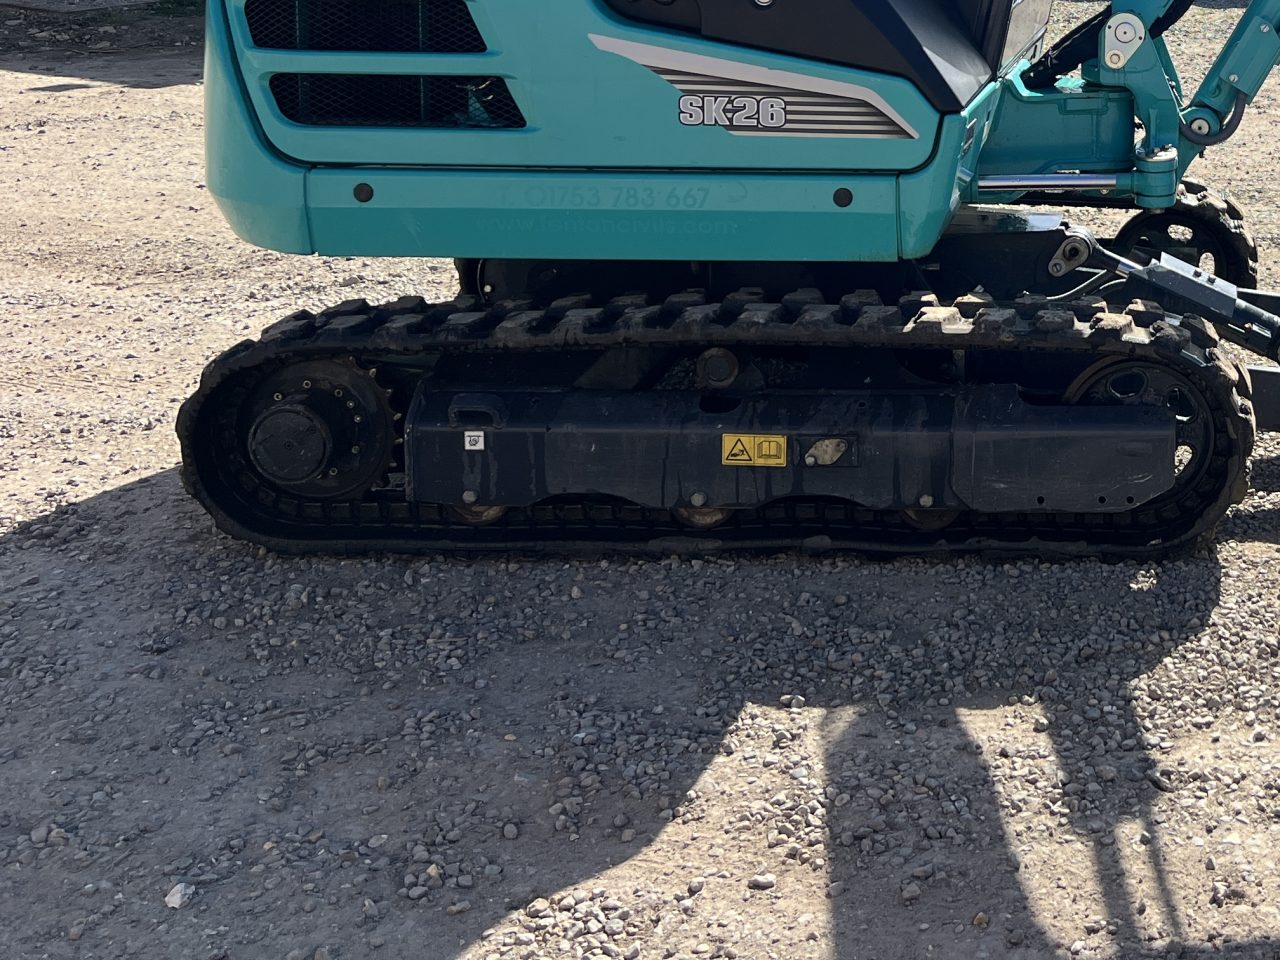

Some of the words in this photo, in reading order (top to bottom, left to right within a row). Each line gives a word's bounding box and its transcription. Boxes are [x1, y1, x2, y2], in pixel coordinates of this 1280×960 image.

[679, 95, 786, 127] SK26
[610, 186, 655, 208] 783
[665, 187, 710, 209] 667
